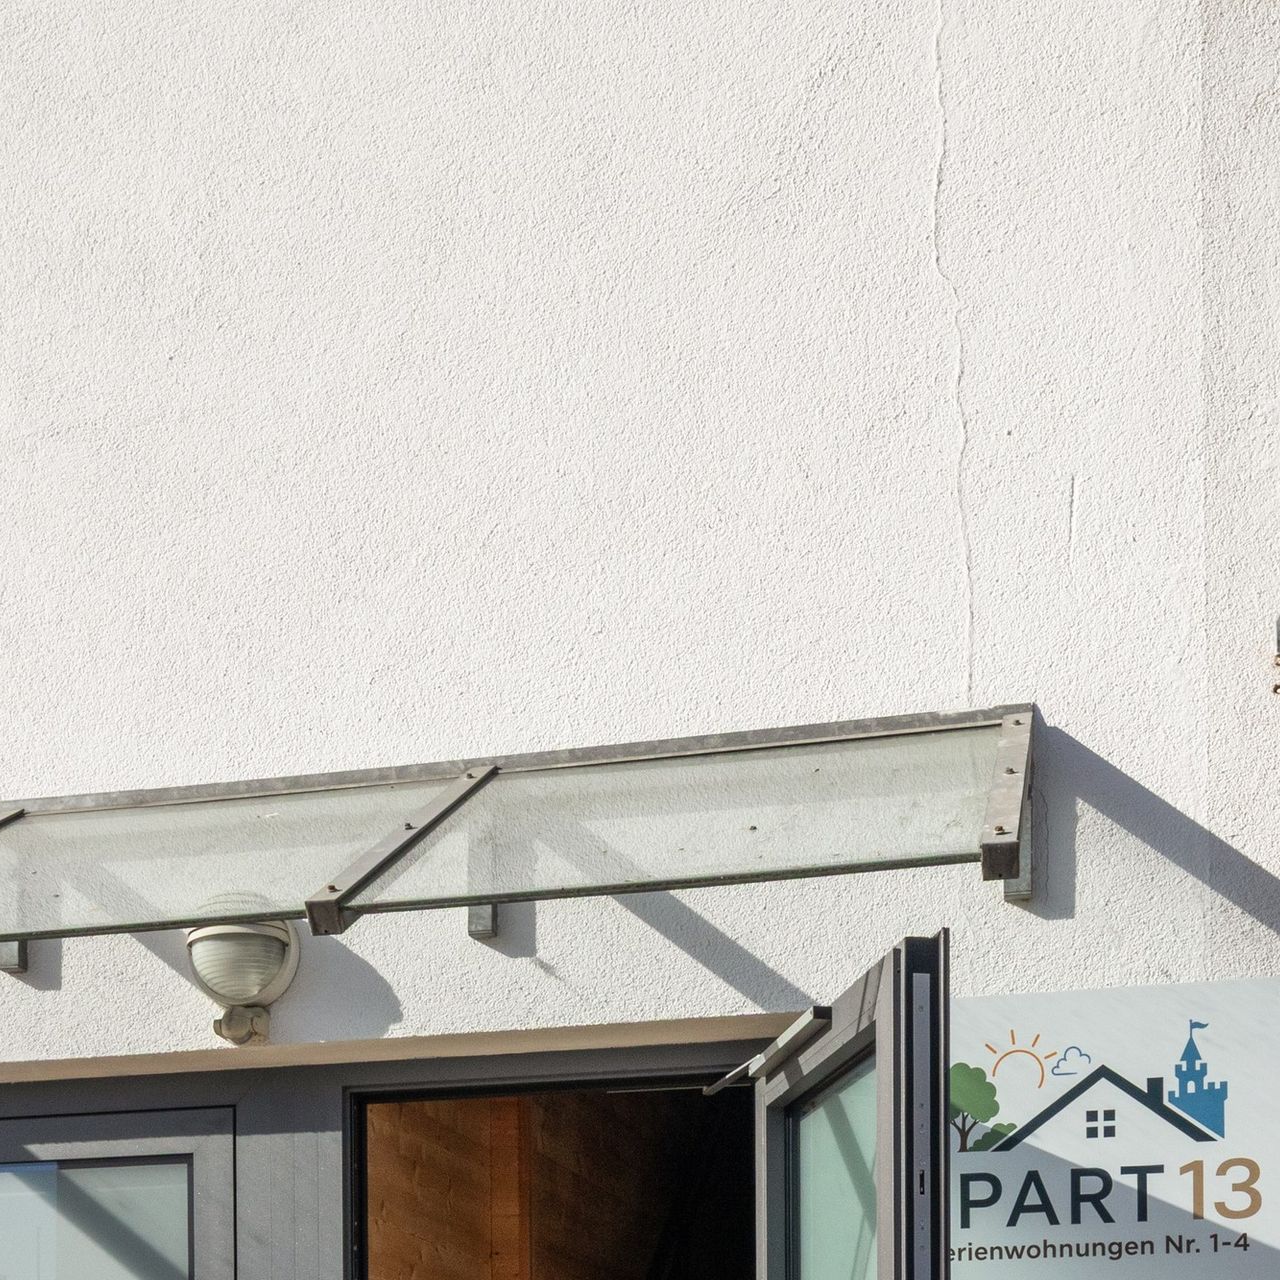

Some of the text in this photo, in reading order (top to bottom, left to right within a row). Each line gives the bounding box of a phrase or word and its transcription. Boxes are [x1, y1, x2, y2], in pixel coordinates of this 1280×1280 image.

[959, 1157, 1264, 1229] PART13
[1164, 1234, 1201, 1254] Nr.
[1209, 1232, 1251, 1253] 1-4
